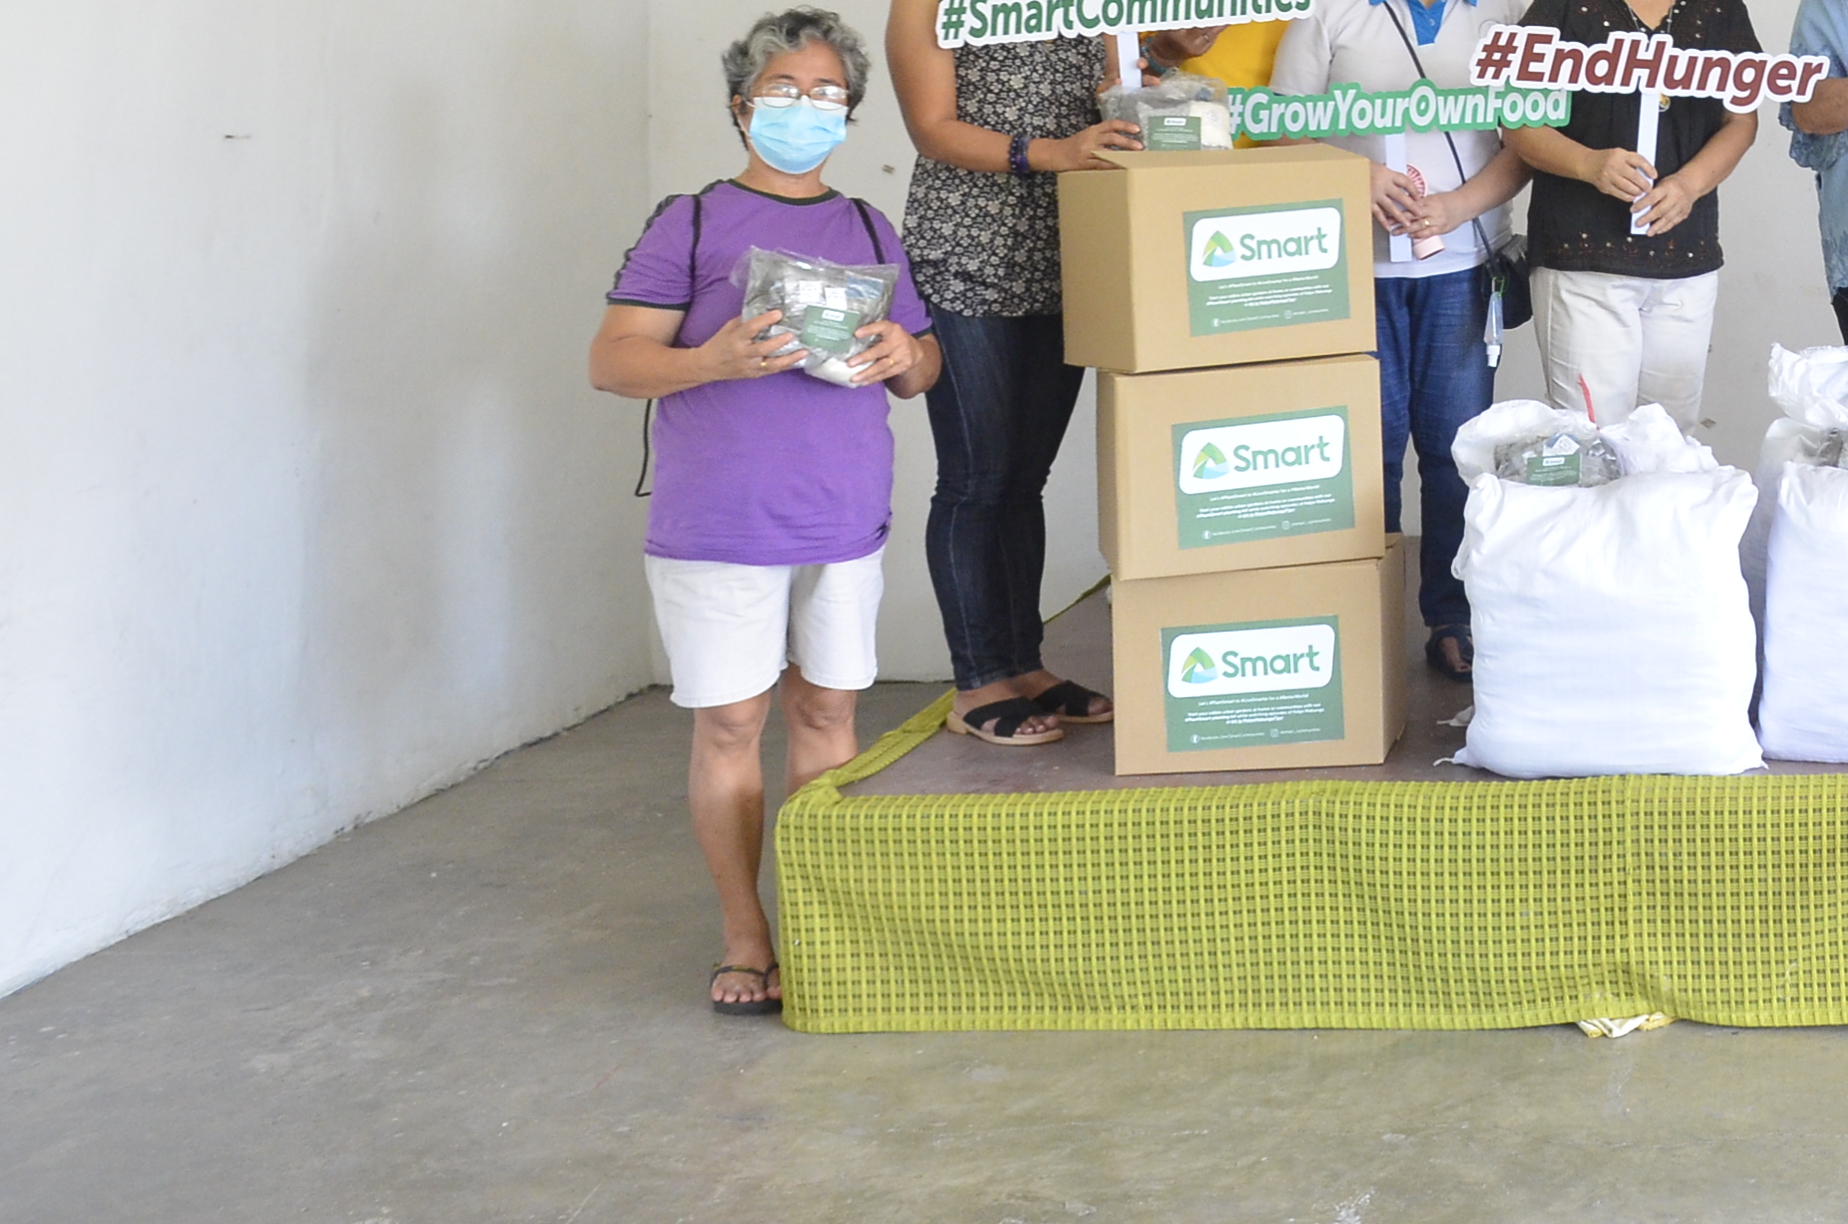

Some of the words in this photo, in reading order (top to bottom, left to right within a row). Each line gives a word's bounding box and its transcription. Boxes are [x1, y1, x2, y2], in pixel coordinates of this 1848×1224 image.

[1474, 30, 1825, 108] #EndHunger
[1228, 85, 1568, 134] #GrowYourOwnFood
[1239, 226, 1329, 262] Smart
[1233, 435, 1331, 472] Smart
[1221, 644, 1320, 678] Smart
